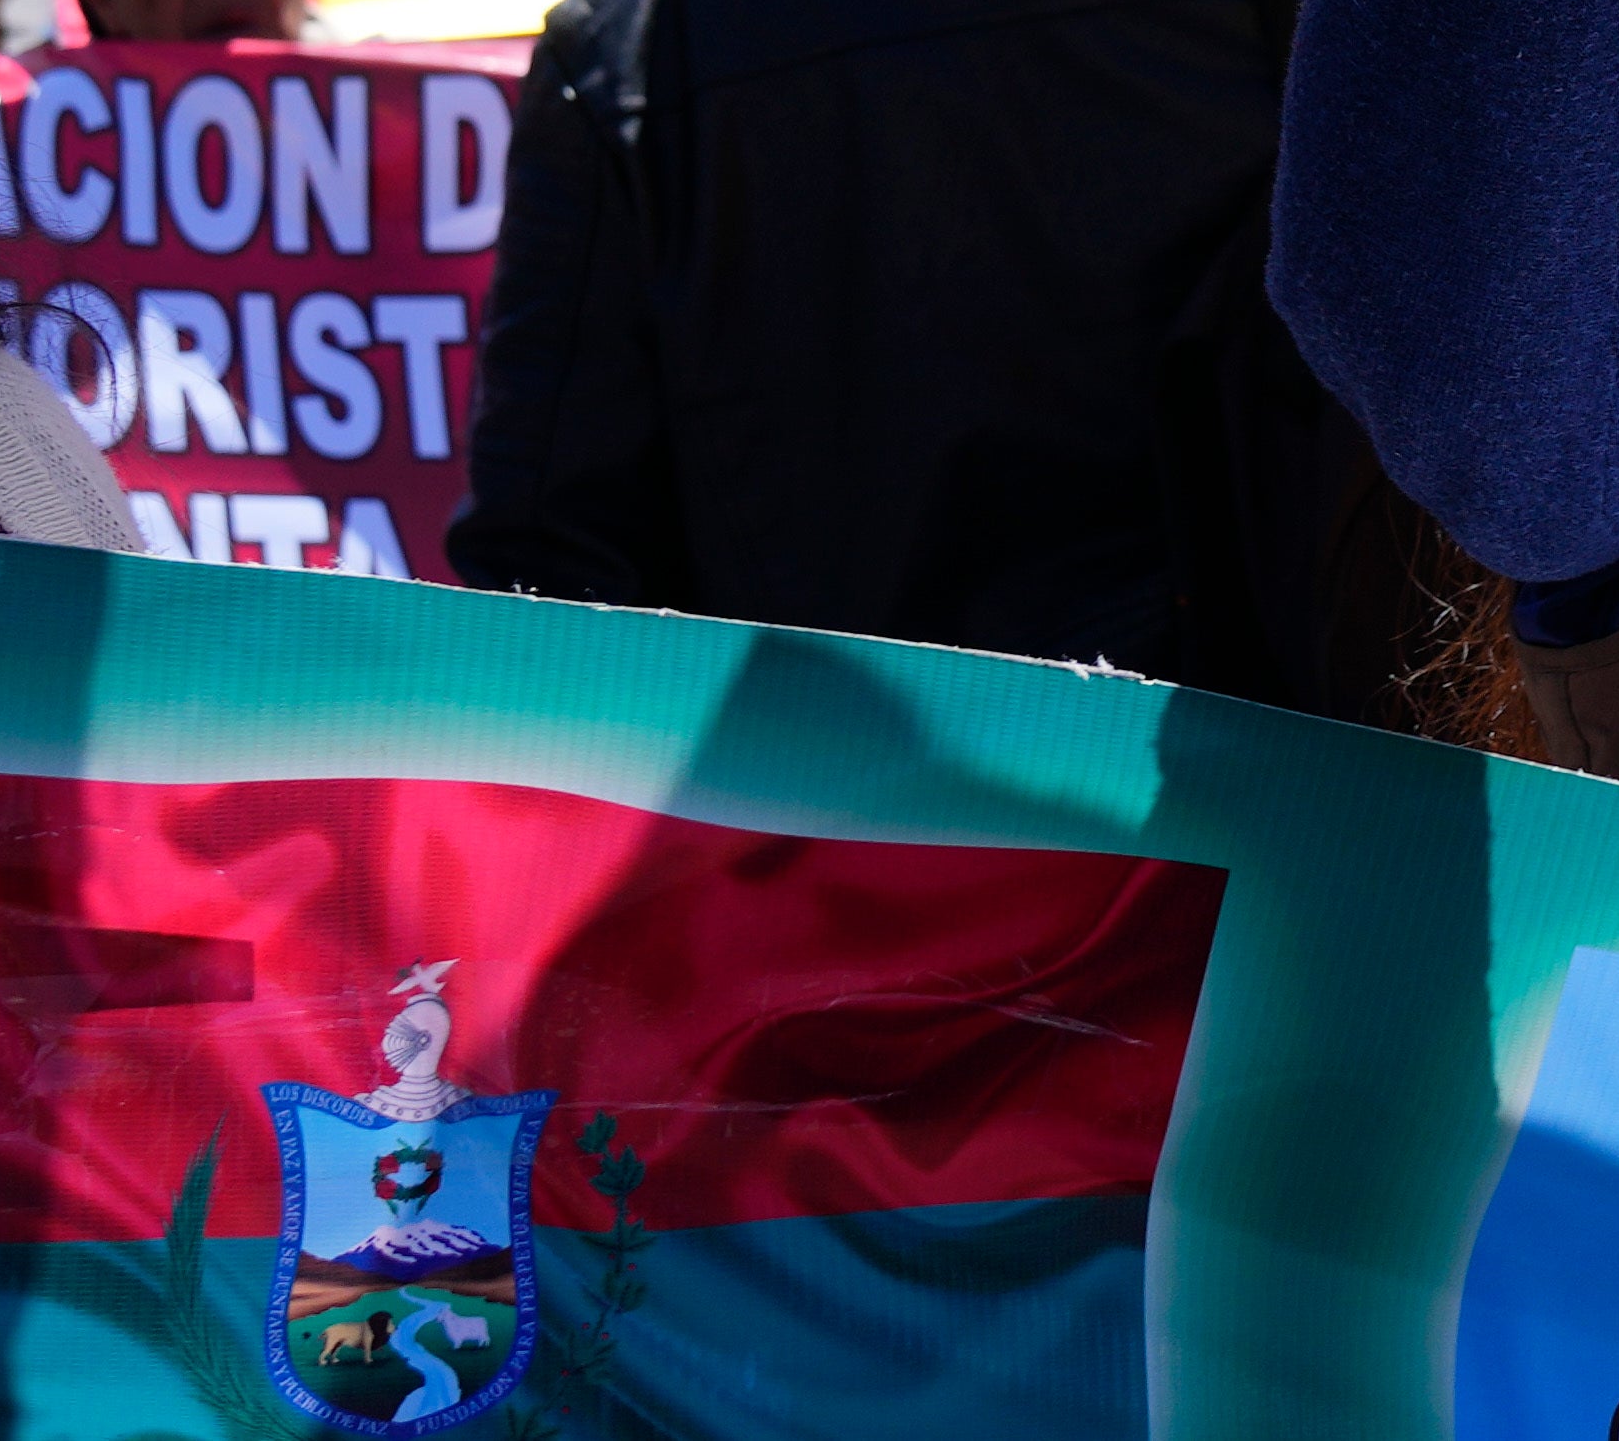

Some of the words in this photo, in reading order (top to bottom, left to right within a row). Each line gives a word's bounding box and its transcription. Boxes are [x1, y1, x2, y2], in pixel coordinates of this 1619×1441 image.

[269, 1085, 300, 1103] LOS
[276, 1109, 294, 1134] EN
[282, 1137, 301, 1170] PAZ
[512, 1119, 542, 1202] MEMORIA
[284, 1174, 302, 1185] Y
[284, 1189, 302, 1243] AMOR
[281, 1246, 295, 1268] SE
[512, 1211, 536, 1314] PERPETUA
[268, 1271, 293, 1364] JUNTARON
[510, 1320, 536, 1369] PARA
[274, 1364, 289, 1377] Y
[415, 1371, 513, 1435] FUNDARON
